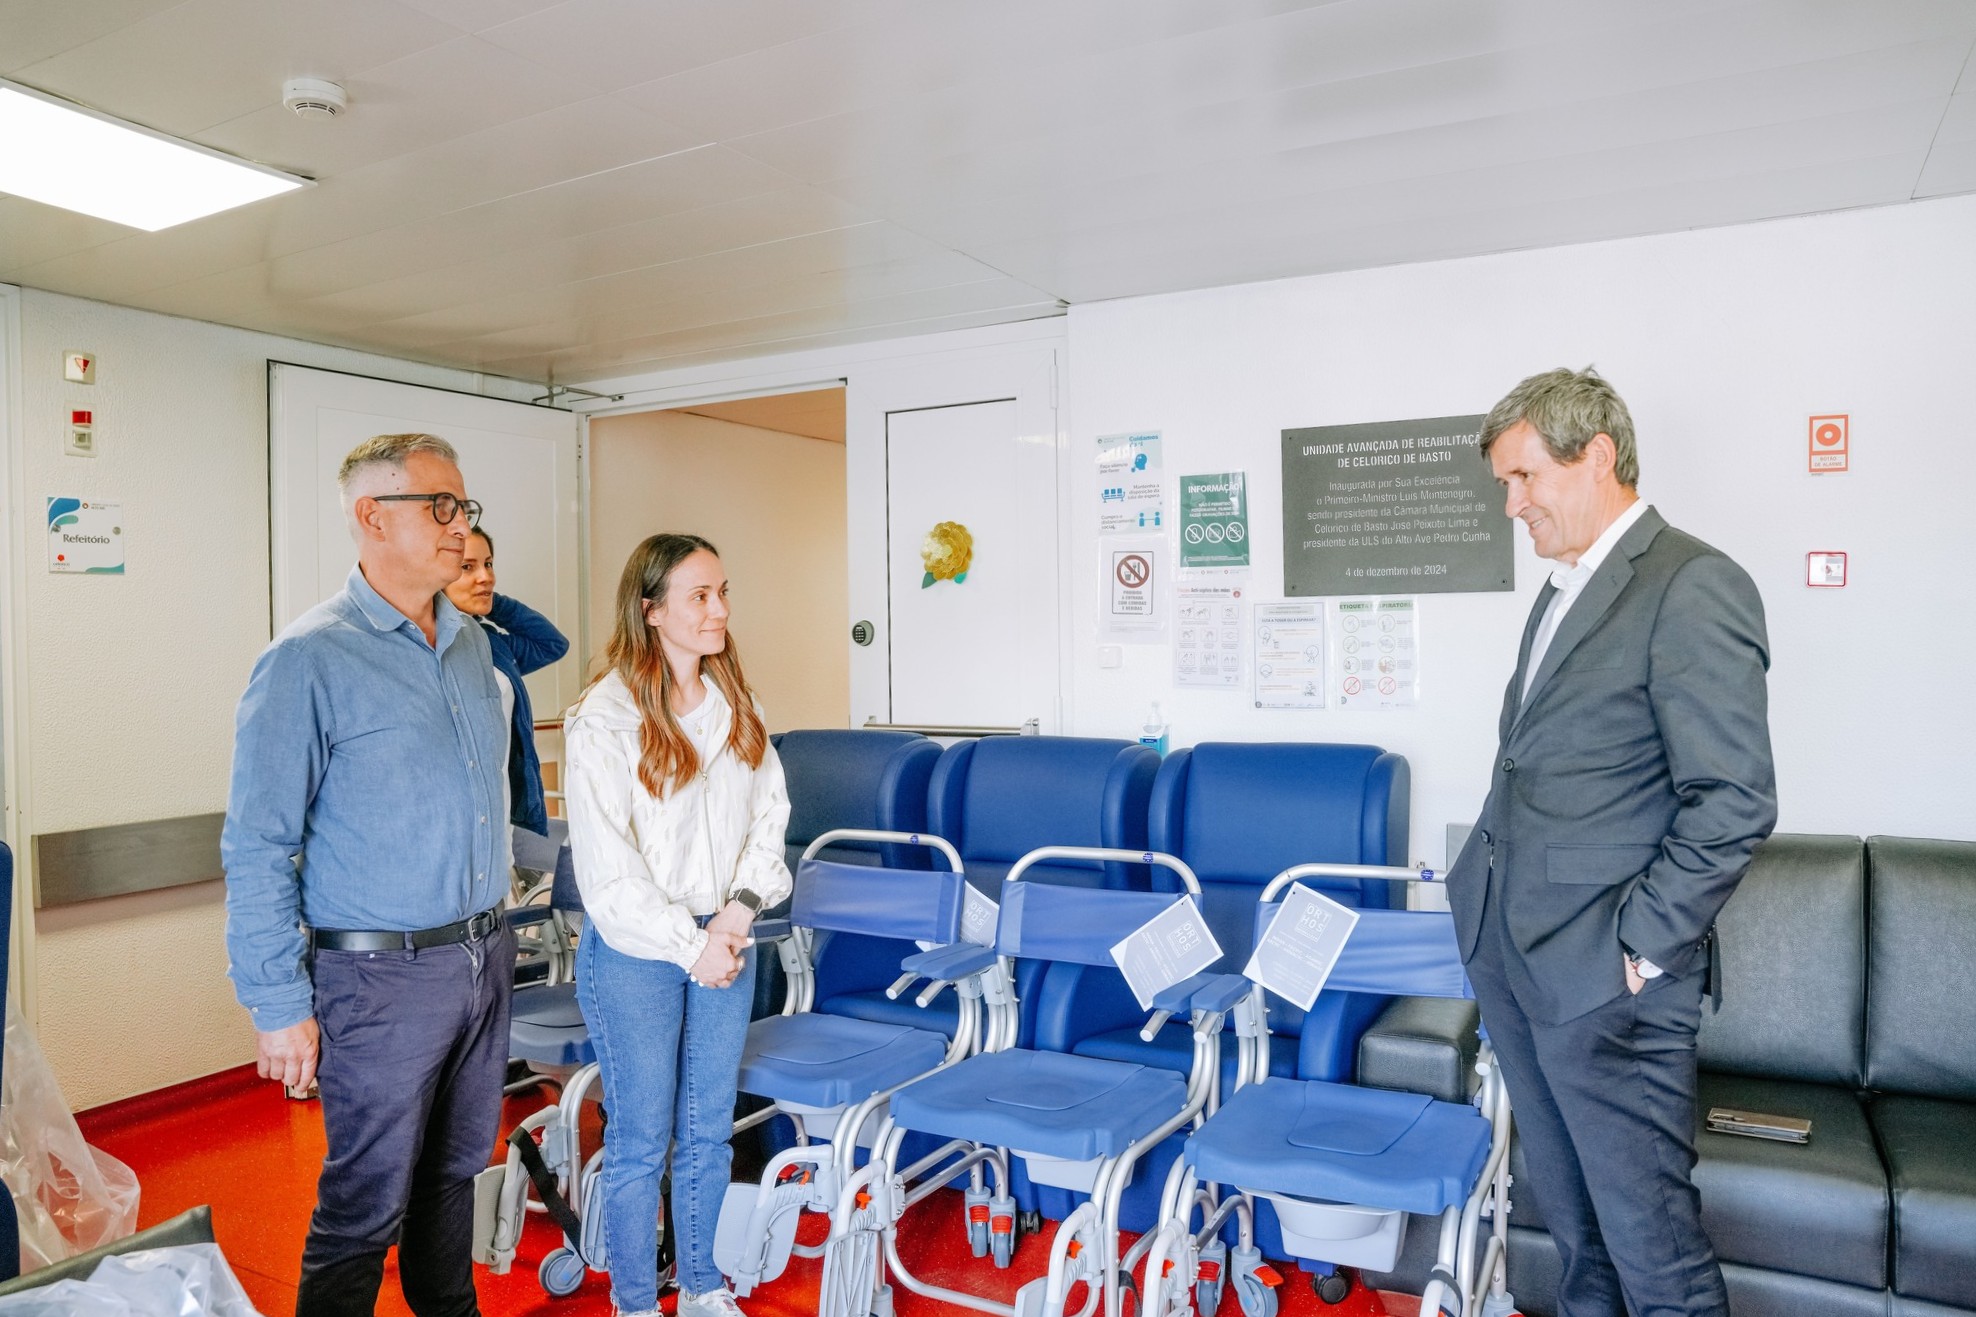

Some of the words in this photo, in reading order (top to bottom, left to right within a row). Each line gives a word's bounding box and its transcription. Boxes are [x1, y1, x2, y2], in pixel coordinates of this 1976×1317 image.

[1303, 443, 1345, 456] UNIDADE
[1347, 439, 1399, 454] AVANÇADA
[1402, 438, 1414, 448] DE
[1417, 432, 1481, 448] REABILITAÇÃ
[1338, 458, 1350, 468] DE
[1353, 454, 1400, 467] CELORICO
[1403, 453, 1416, 463] DE
[1419, 451, 1452, 463] BASTO
[1188, 482, 1240, 494] INFORMAÇÃO
[1329, 480, 1376, 493] Inaugurada
[1378, 480, 1393, 490] por
[1395, 477, 1412, 488] Sua
[1414, 474, 1461, 487] Excelência
[1316, 498, 1322, 506] o
[1324, 493, 1397, 505] Primeiro-Ministro
[1307, 510, 1333, 521] sendo
[1335, 508, 1379, 520] presidente
[1381, 507, 1392, 516] da
[1394, 505, 1428, 516] Câmara
[1430, 502, 1473, 514] Municipal
[1475, 502, 1486, 512] de
[1314, 523, 1348, 534] Celorico
[1351, 522, 1362, 532] de
[1364, 521, 1388, 532] Basto
[1413, 519, 1446, 530] Peixoto
[1448, 518, 1470, 528] Lima
[1472, 518, 1479, 527] e
[63, 533, 110, 544] Refeitório
[1303, 537, 1346, 550] presidente
[1348, 536, 1359, 546] da
[1361, 535, 1379, 546] ULS
[1382, 535, 1393, 545] do
[1395, 534, 1412, 545] Alto
[1415, 534, 1431, 543] Ave
[1433, 532, 1460, 543] Pedro
[1462, 531, 1491, 542] Cunha
[1345, 567, 1351, 577] 4
[1353, 567, 1364, 577] de
[1366, 566, 1408, 577] dezembro
[1411, 566, 1422, 576] de
[1424, 564, 1447, 575] 2024
[966, 909, 984, 925] HOS
[971, 903, 989, 919] ORT
[1307, 905, 1329, 920] ORT
[1301, 915, 1325, 932] HOS
[1175, 929, 1191, 951] HOS
[1183, 923, 1200, 944] ORT
